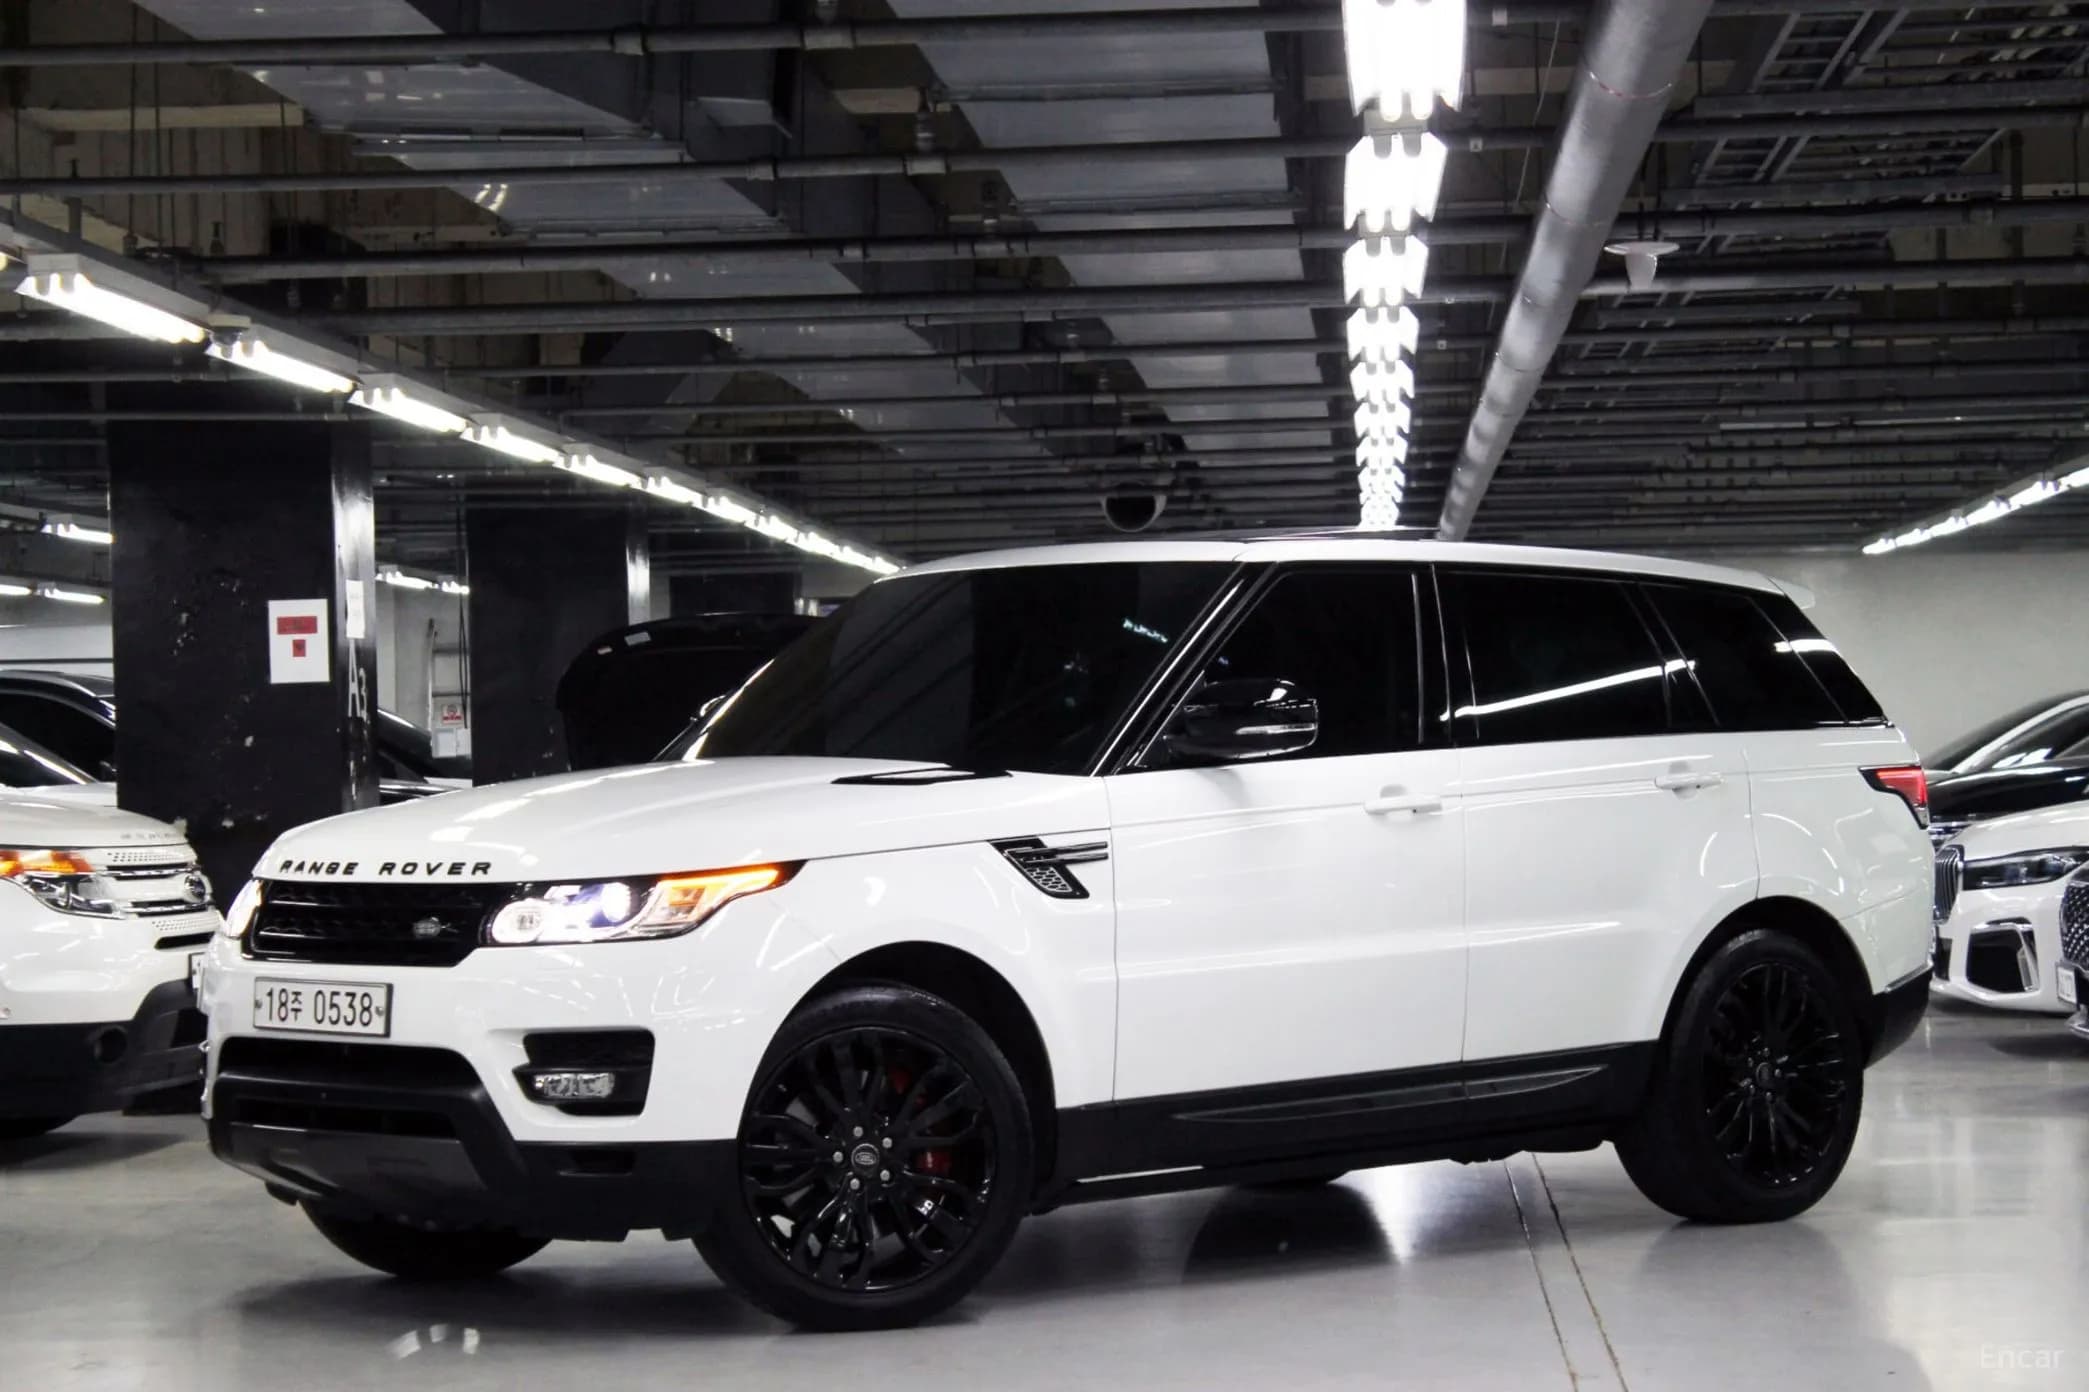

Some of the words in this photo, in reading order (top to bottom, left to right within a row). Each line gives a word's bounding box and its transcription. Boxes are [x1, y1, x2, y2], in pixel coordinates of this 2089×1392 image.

[279, 859, 359, 876] RANGE
[378, 862, 492, 876] ROVER
[266, 987, 303, 1022] 18주
[313, 989, 373, 1026] 0538
